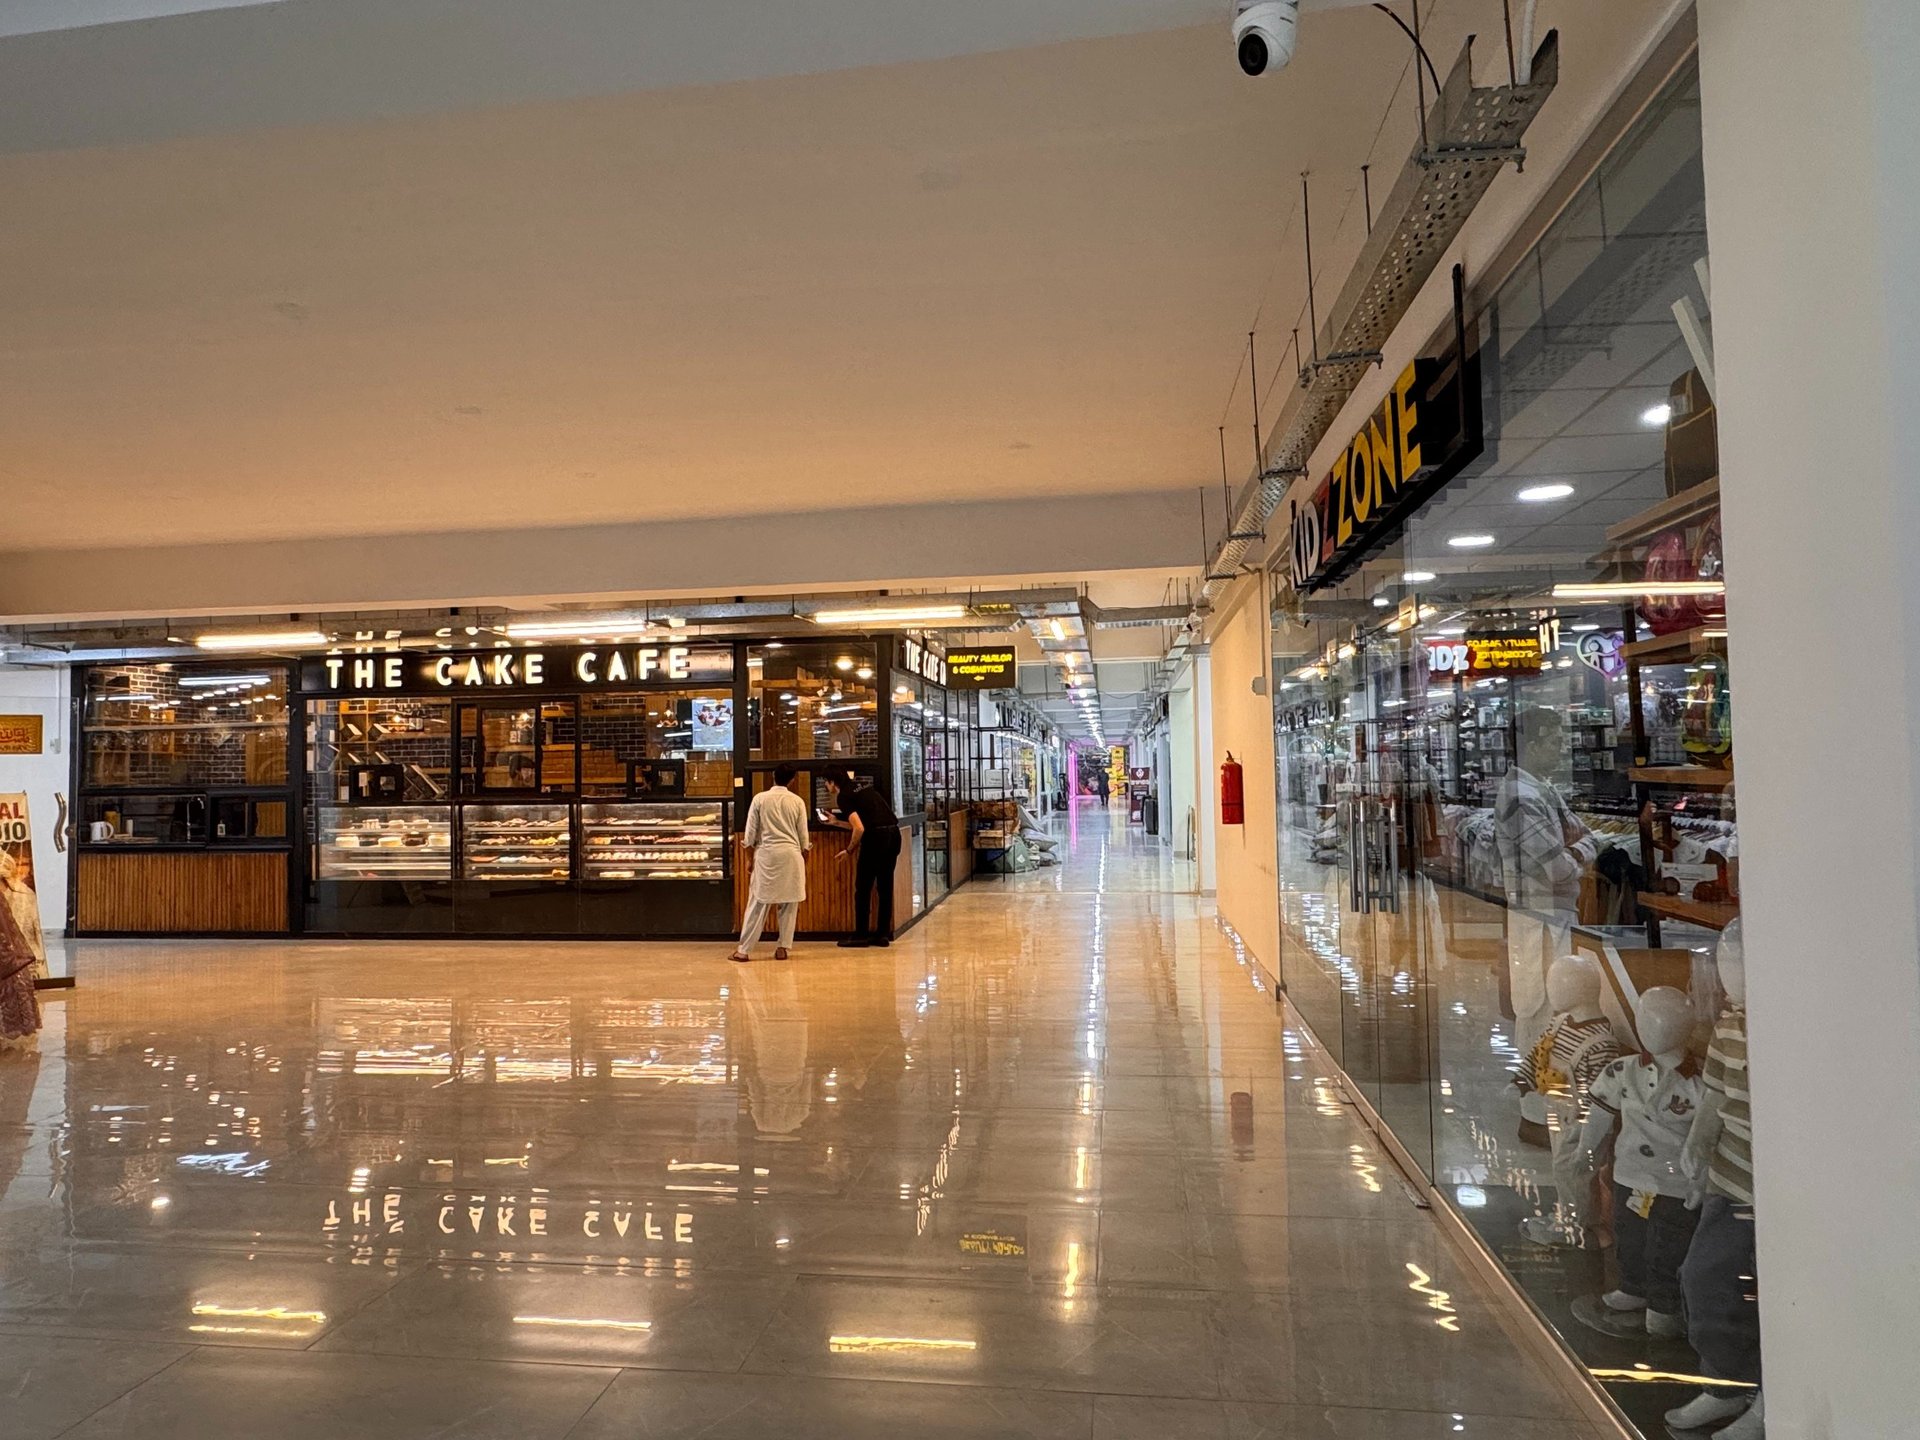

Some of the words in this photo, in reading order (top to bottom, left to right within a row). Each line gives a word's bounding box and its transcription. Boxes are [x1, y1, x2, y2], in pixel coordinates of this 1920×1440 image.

[905, 639, 921, 674] THE
[948, 654, 980, 663] BEAUTY
[980, 653, 1012, 662] PARLOR
[326, 658, 403, 689] THE
[435, 654, 544, 686] CAKE
[577, 647, 691, 682] CAFE
[959, 665, 1004, 674] COSMETICS
[0, 822, 26, 840] IO
